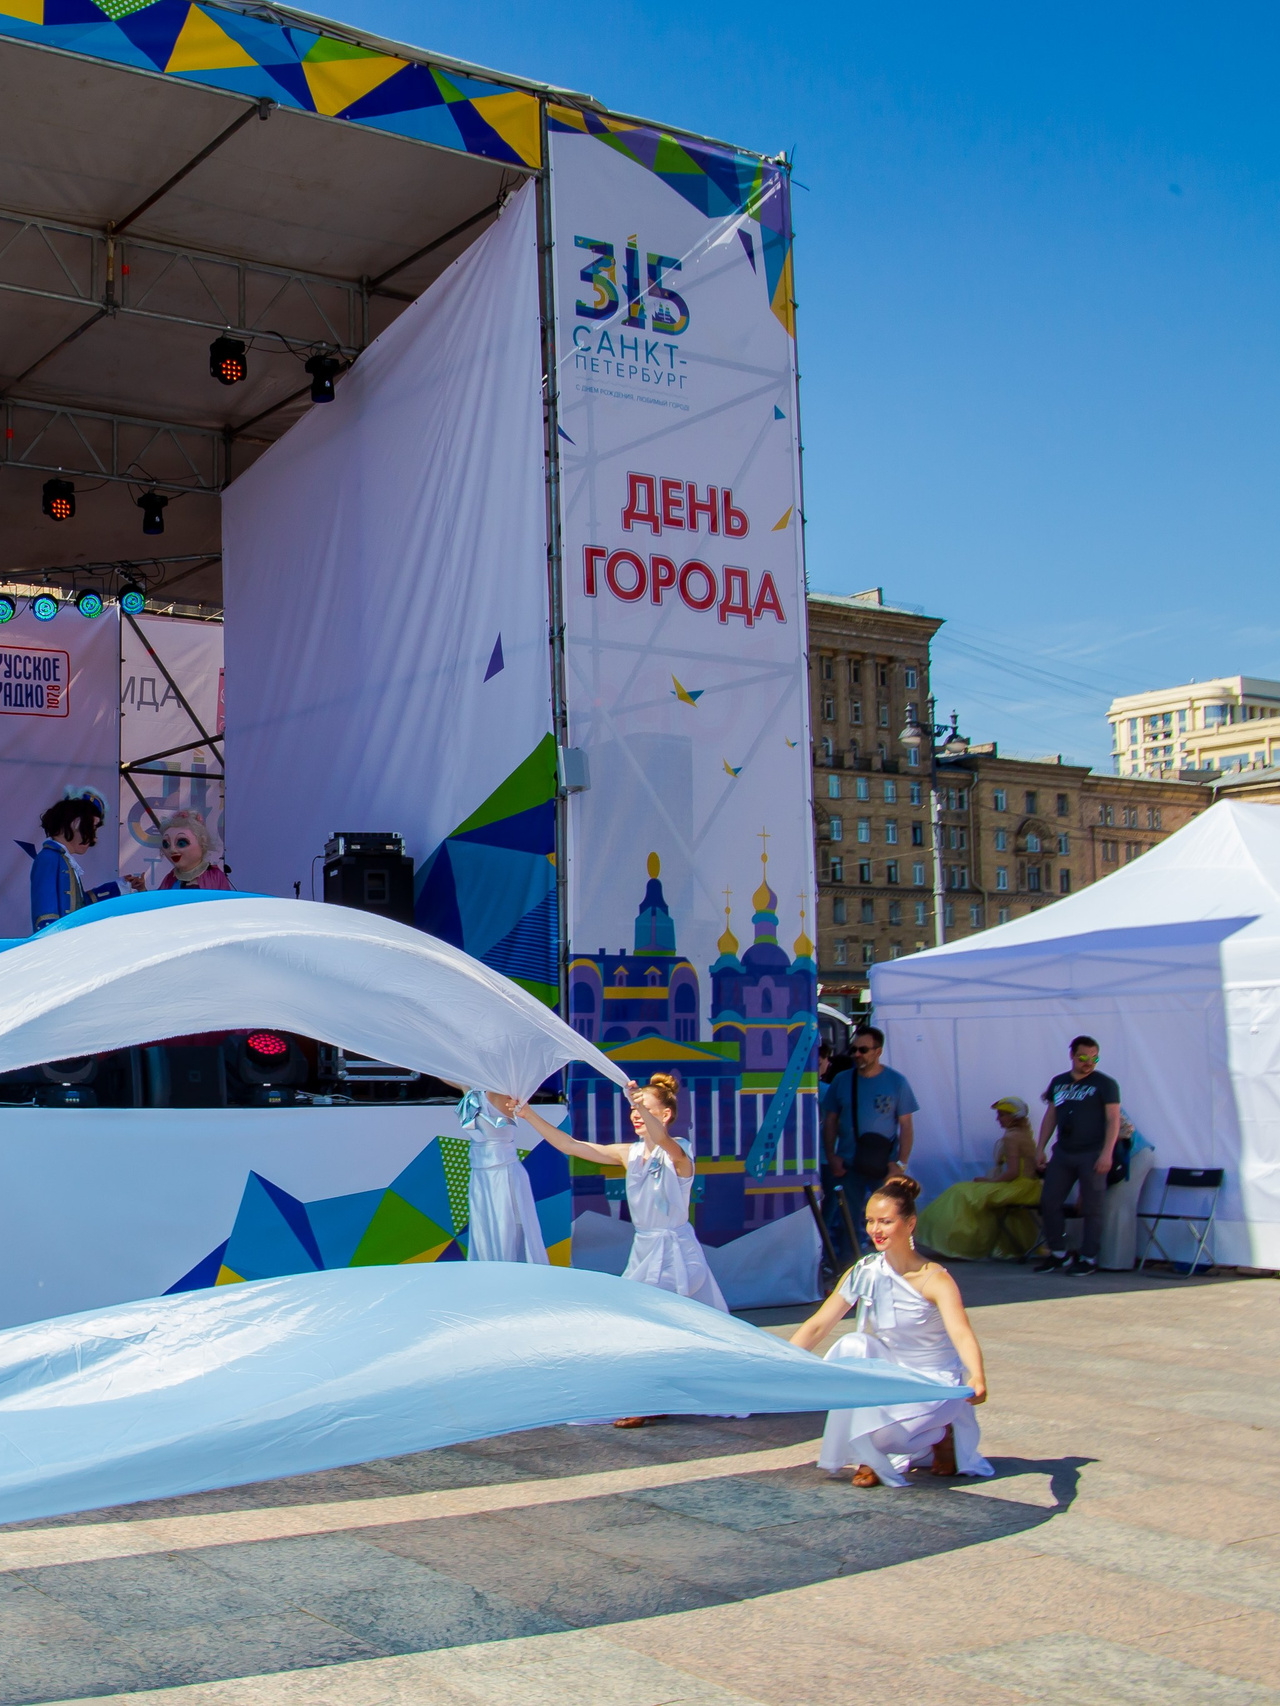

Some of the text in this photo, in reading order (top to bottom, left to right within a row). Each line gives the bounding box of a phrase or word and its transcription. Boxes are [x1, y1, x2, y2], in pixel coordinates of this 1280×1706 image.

[573, 325, 687, 369] САНКТ-
[575, 354, 687, 389] ПЕТЕРБУРГ
[621, 471, 749, 539] ДЕНЬ
[582, 544, 787, 628] ГОРОДА
[46, 685, 61, 710] 107.8
